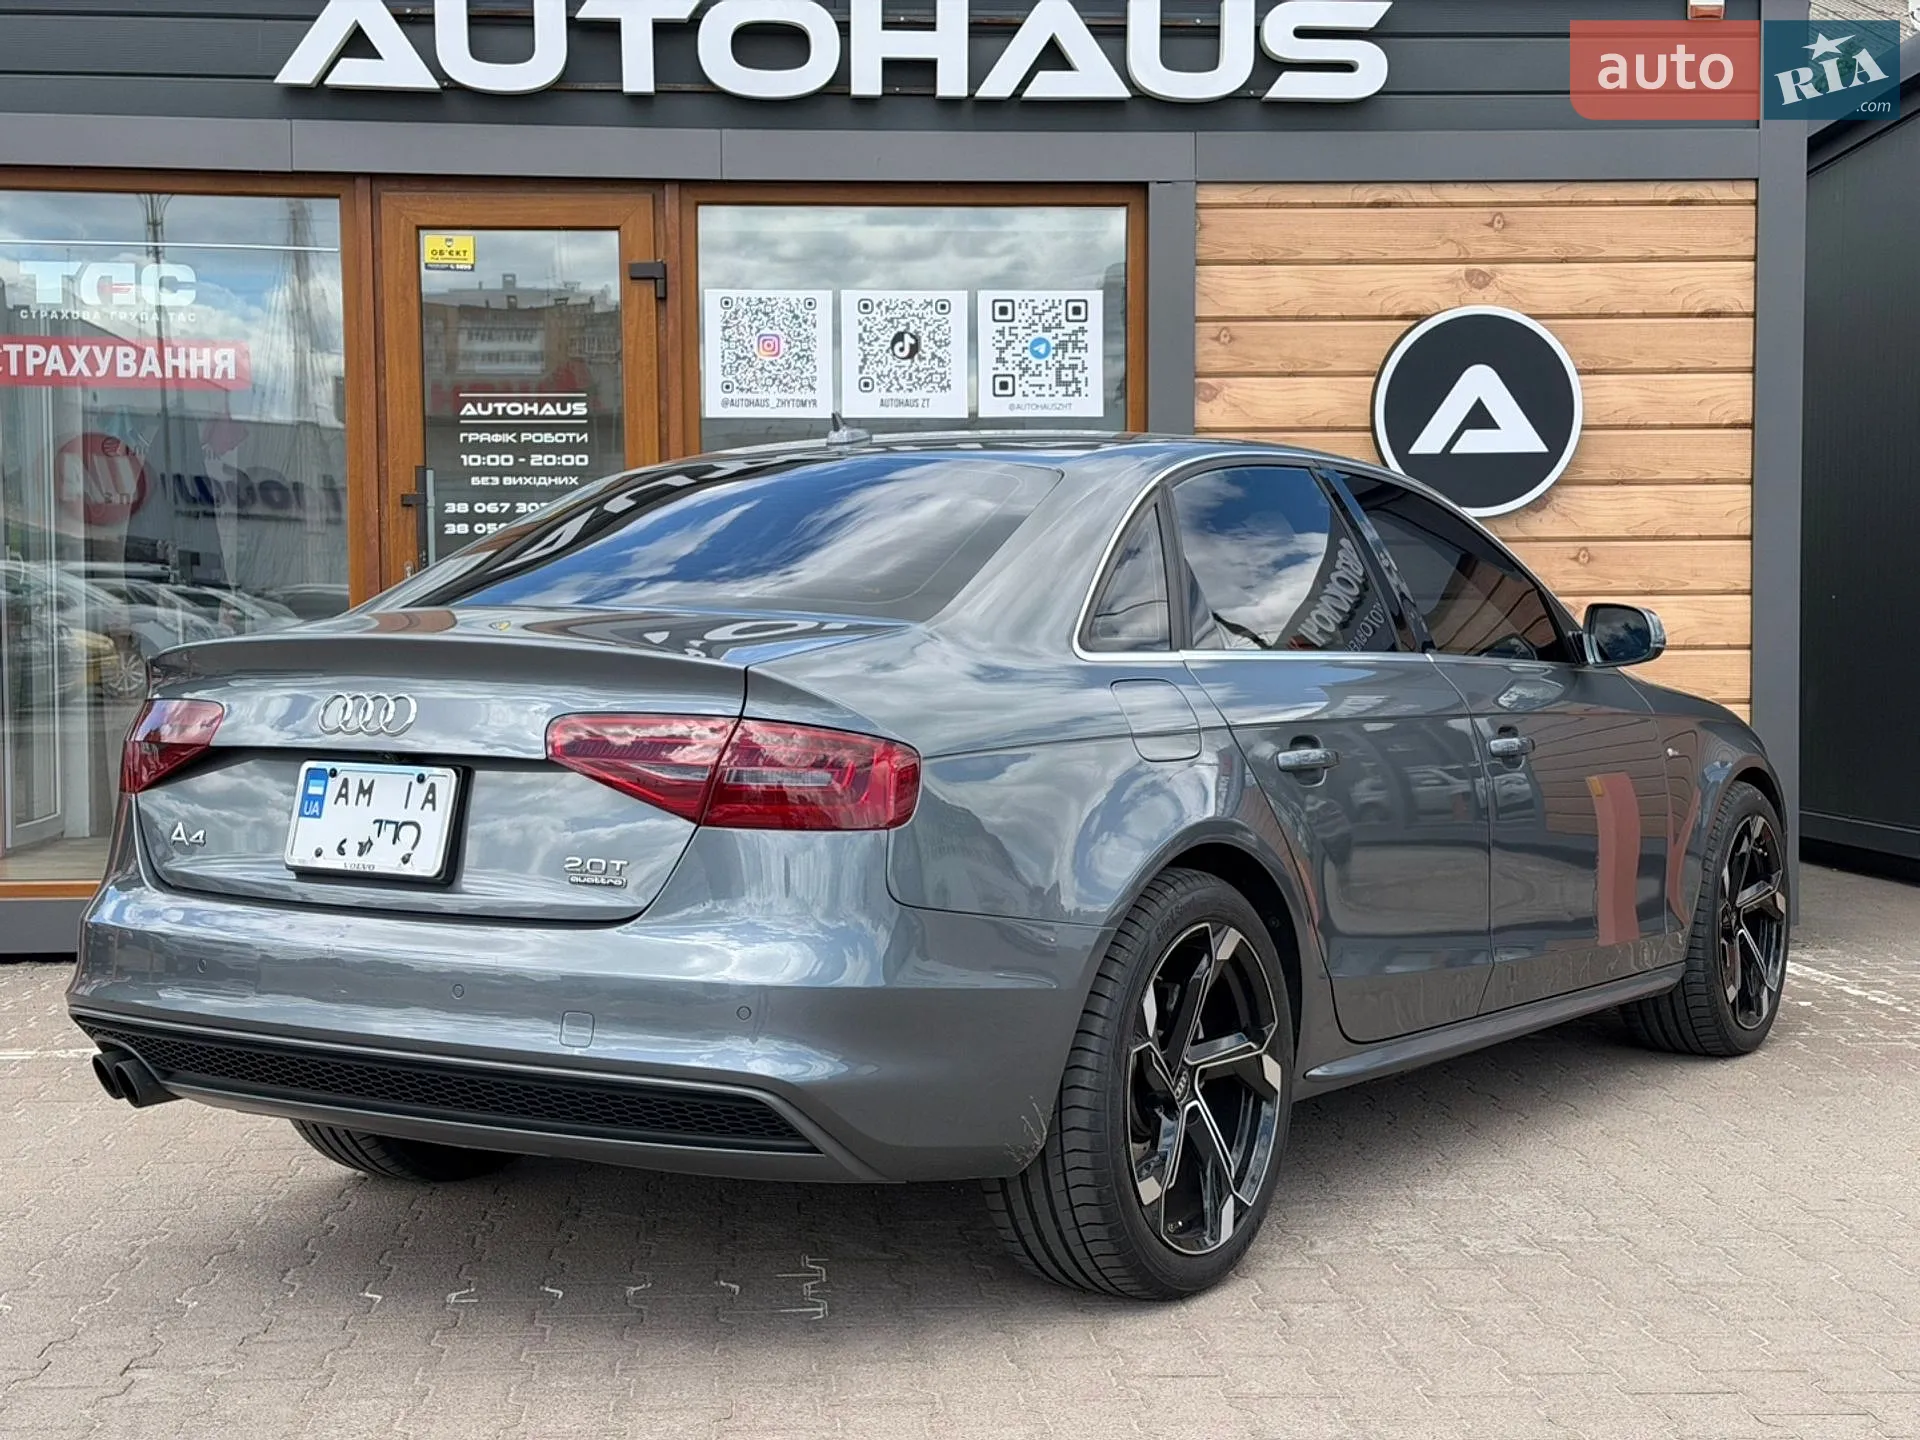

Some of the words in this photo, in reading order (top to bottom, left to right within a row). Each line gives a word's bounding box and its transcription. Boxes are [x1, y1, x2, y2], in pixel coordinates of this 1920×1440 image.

[274, 0, 1392, 106] AUTOHAUS
[19, 309, 100, 321] СТРАХОВА
[109, 311, 160, 321] ГРУПА
[169, 312, 197, 322] ТАС
[0, 343, 236, 380] ТРАХУВАННЯ
[459, 402, 588, 416] AUTOHAUS
[720, 397, 818, 409] @AUTOHAUS_ZHYTOMYR
[879, 397, 920, 408] AUTOHAUS
[921, 398, 930, 408] ZT
[459, 432, 517, 444] ГРАФІК
[520, 433, 589, 444] РОБОТИ
[460, 454, 514, 467] 10:00
[530, 454, 589, 467] 20:00
[470, 476, 500, 486] БЕЗ
[502, 476, 579, 488] ВИХІДНИХ
[444, 502, 469, 514] 38
[473, 502, 511, 514] 067
[444, 523, 469, 535] 38
[334, 777, 375, 807] AM
[303, 800, 320, 816] UA
[171, 821, 206, 847] A4
[569, 875, 624, 887] quattro
